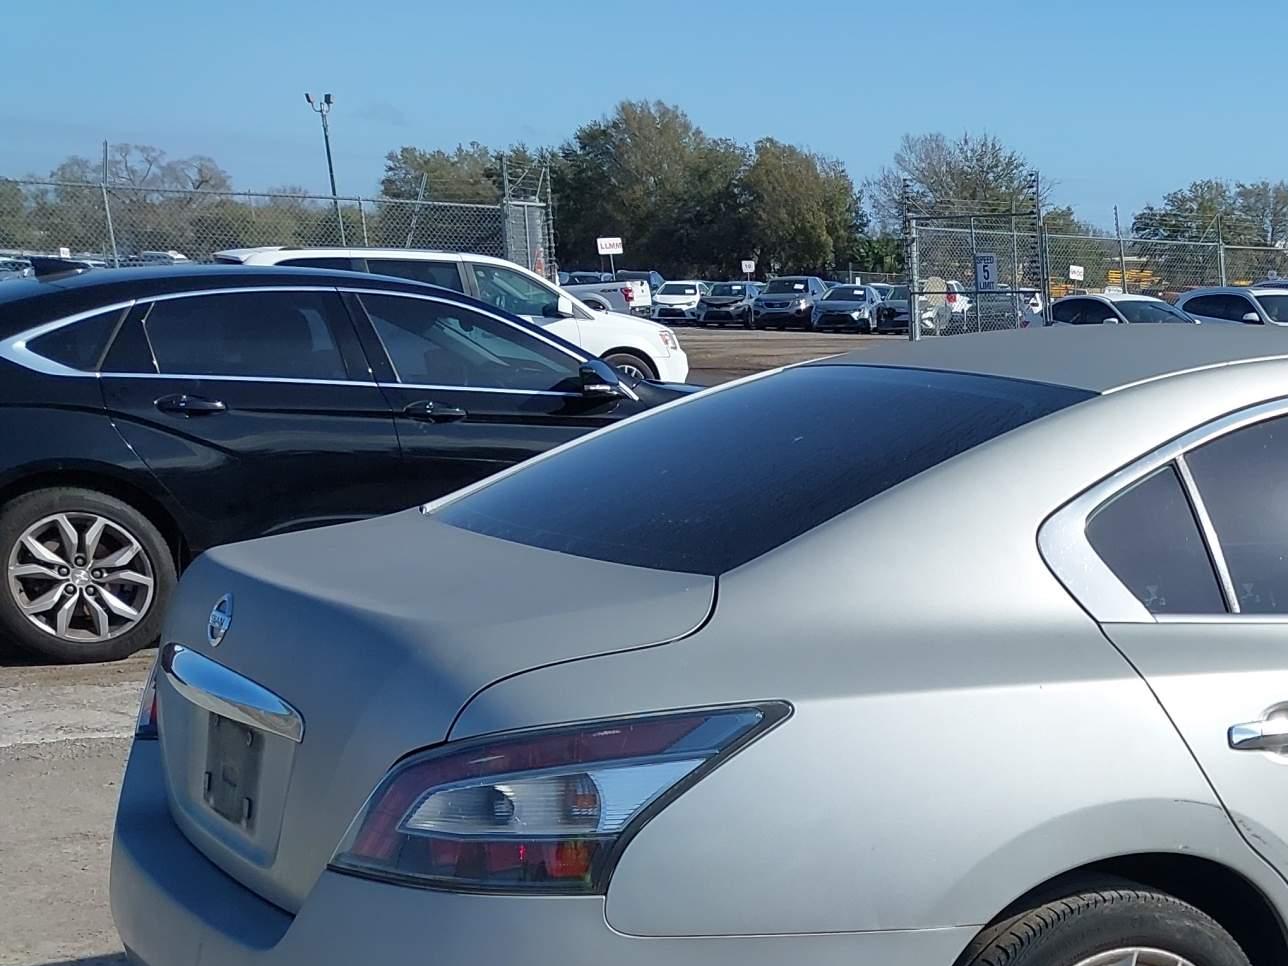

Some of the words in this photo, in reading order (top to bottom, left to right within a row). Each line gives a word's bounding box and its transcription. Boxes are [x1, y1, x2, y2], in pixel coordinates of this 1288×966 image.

[975, 255, 995, 265] SPEED
[982, 264, 990, 281] 5
[980, 281, 995, 290] LIMIT
